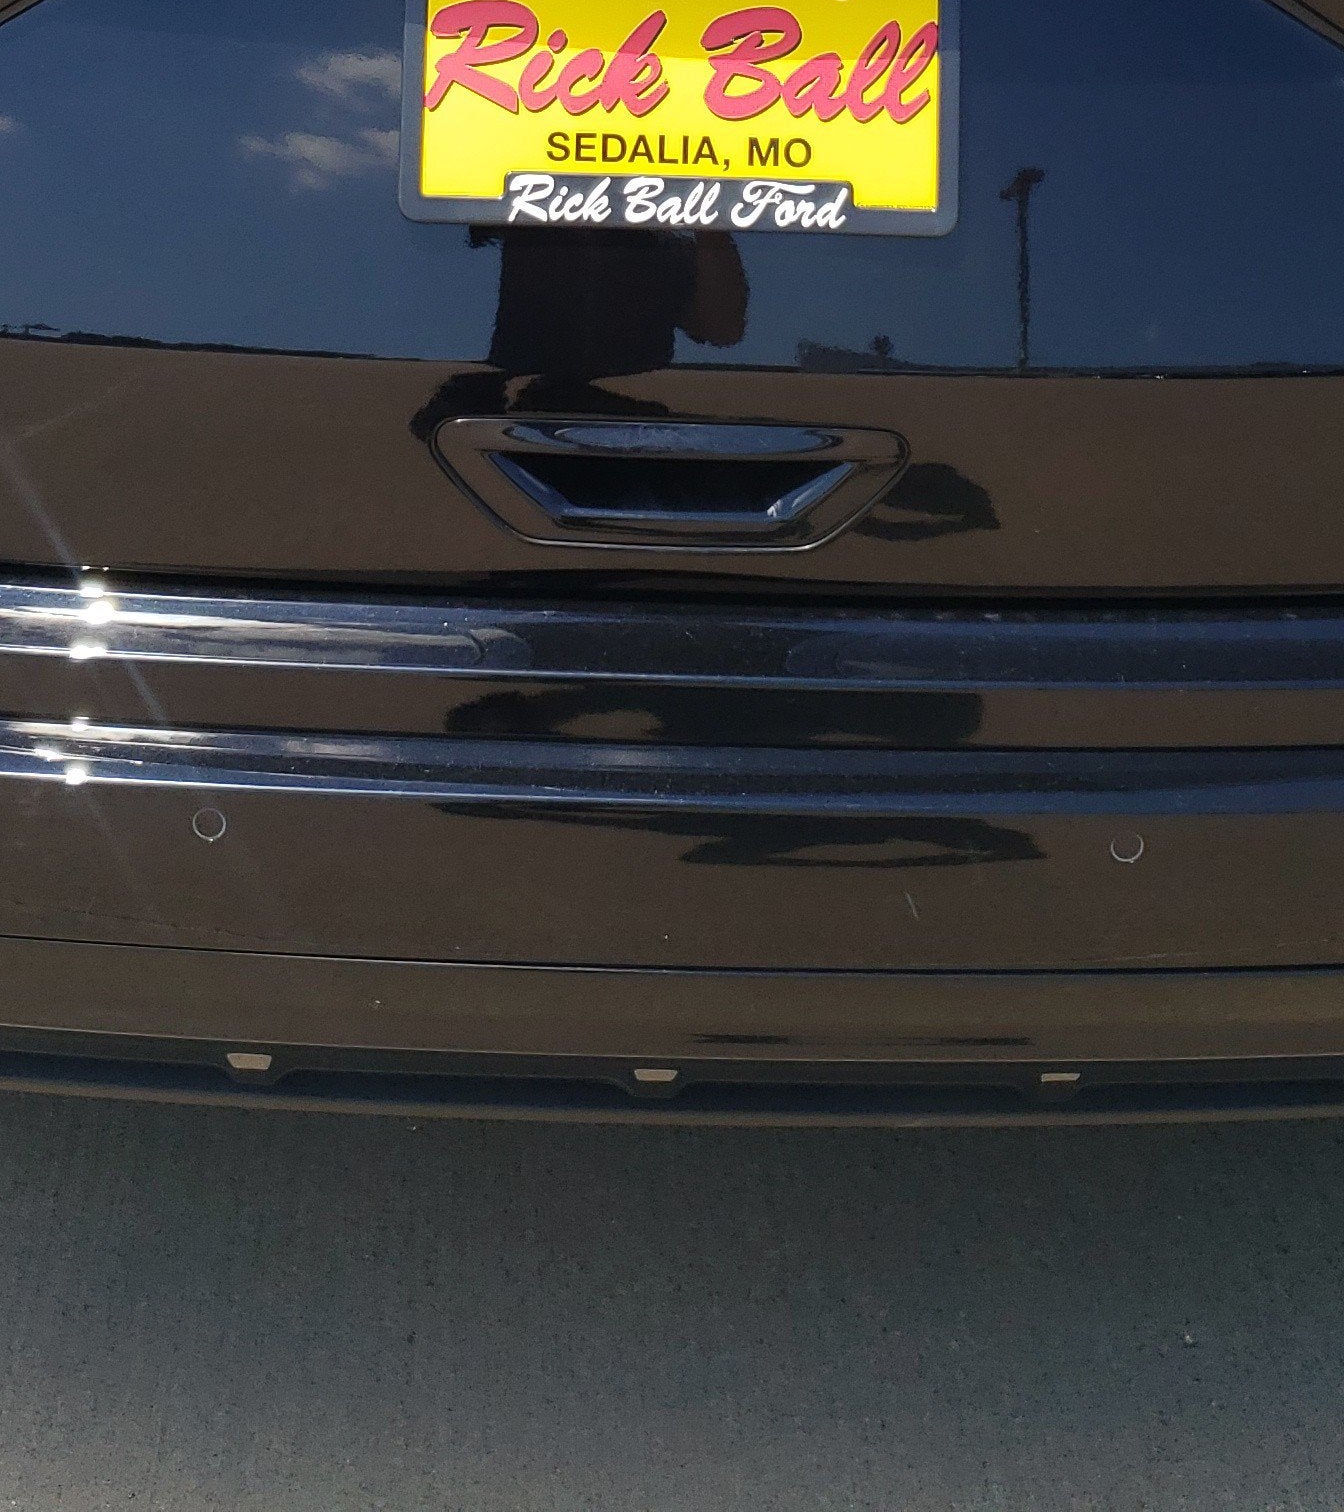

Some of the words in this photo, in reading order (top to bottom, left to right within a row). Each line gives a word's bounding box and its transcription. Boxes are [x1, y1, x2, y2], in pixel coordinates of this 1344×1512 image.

[700, 6, 939, 124] Ball
[545, 131, 732, 171] SEDALIA,
[746, 138, 813, 168] MO
[507, 173, 612, 225] Rick
[622, 177, 719, 225] Ball
[730, 182, 849, 230] Ford
